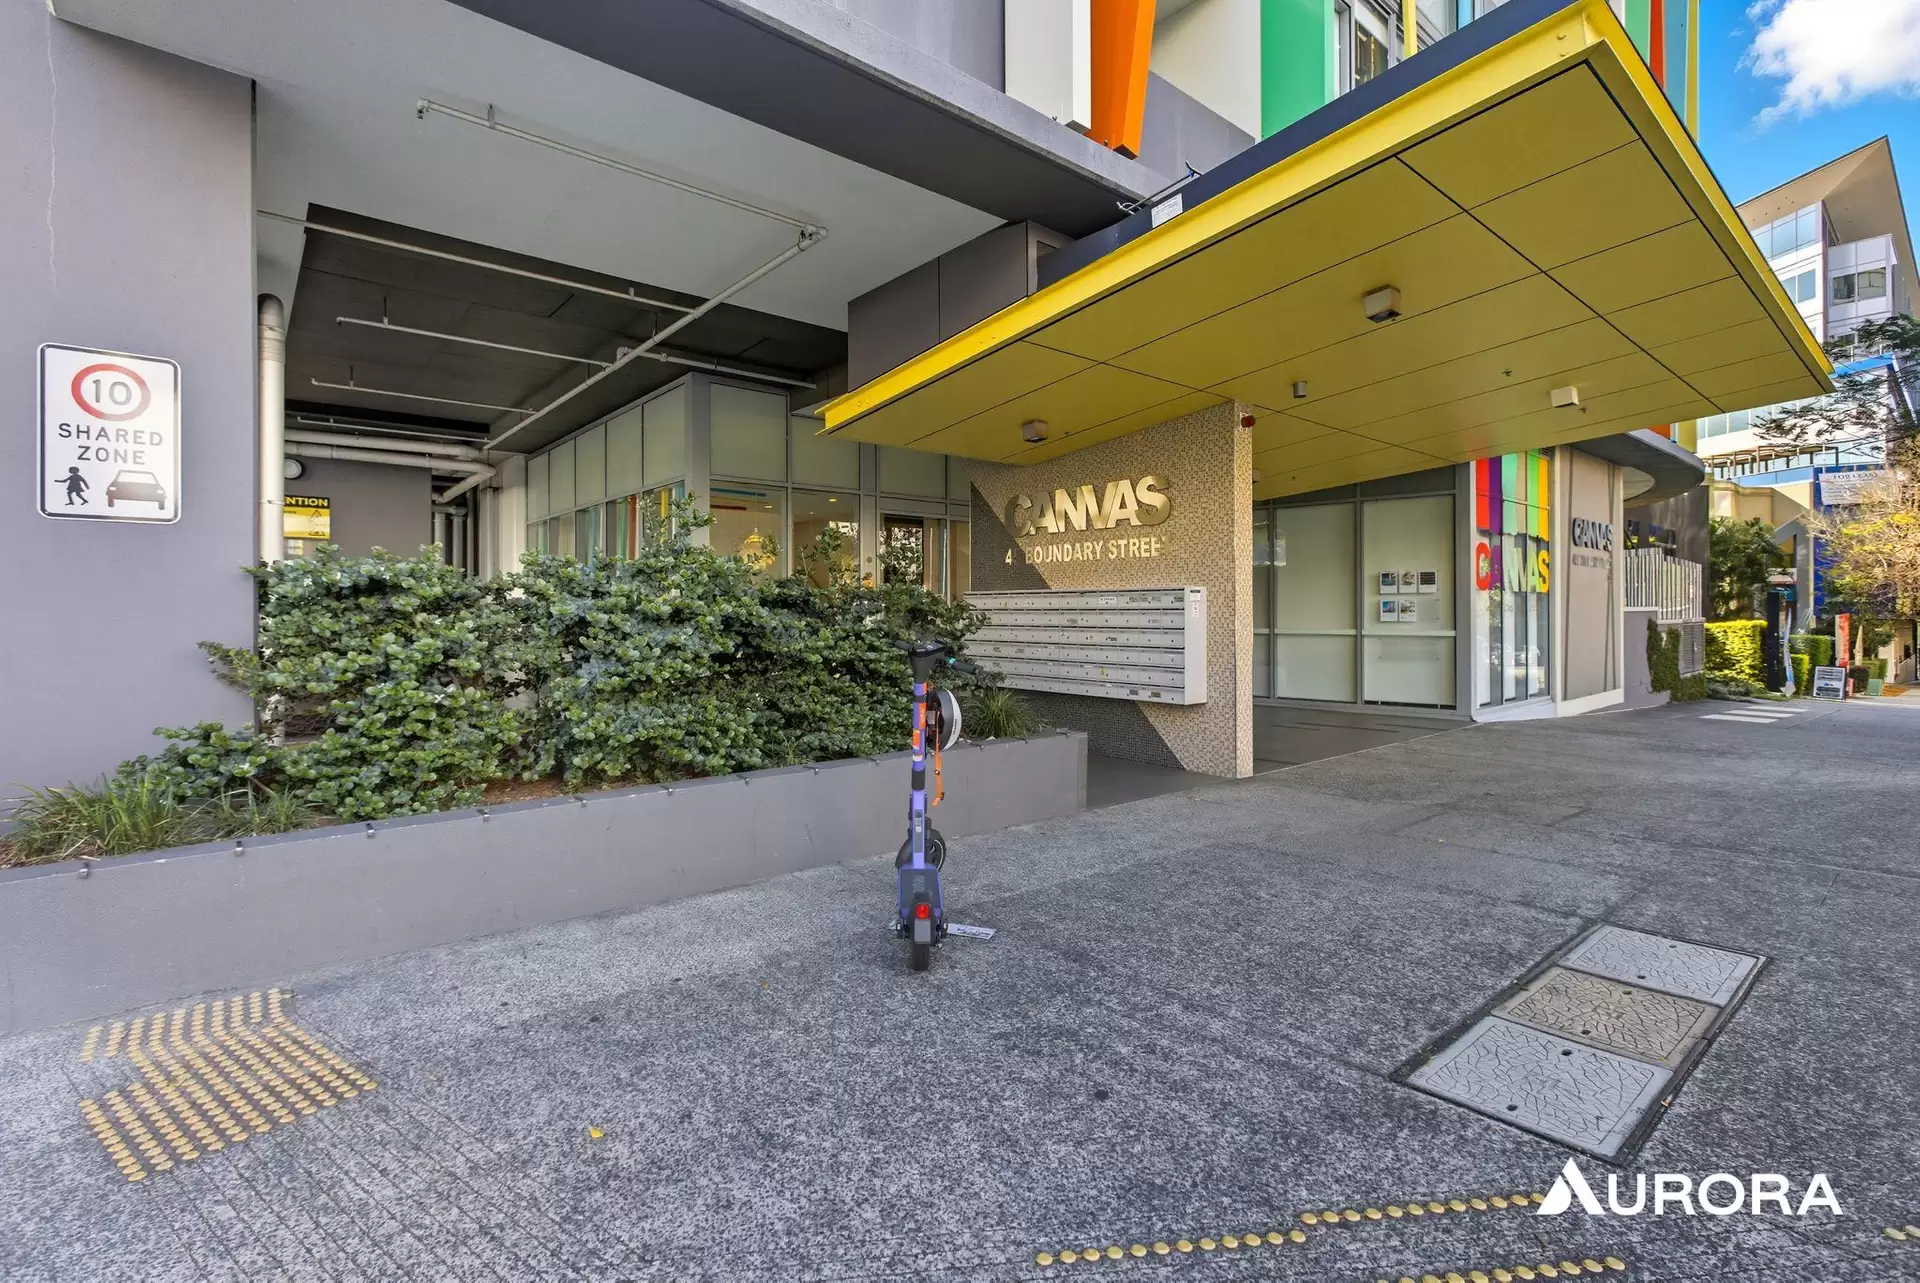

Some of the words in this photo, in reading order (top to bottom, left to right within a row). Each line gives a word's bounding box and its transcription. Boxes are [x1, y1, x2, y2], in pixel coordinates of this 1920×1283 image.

[92, 378, 133, 406] 10
[58, 423, 163, 446] SHARED
[77, 446, 146, 465] ZONE
[1004, 475, 1171, 538] CANVAS
[1572, 517, 1613, 552] CANVAS
[1025, 540, 1104, 564] BOUNDARY
[1476, 542, 1550, 593] CANVAS
